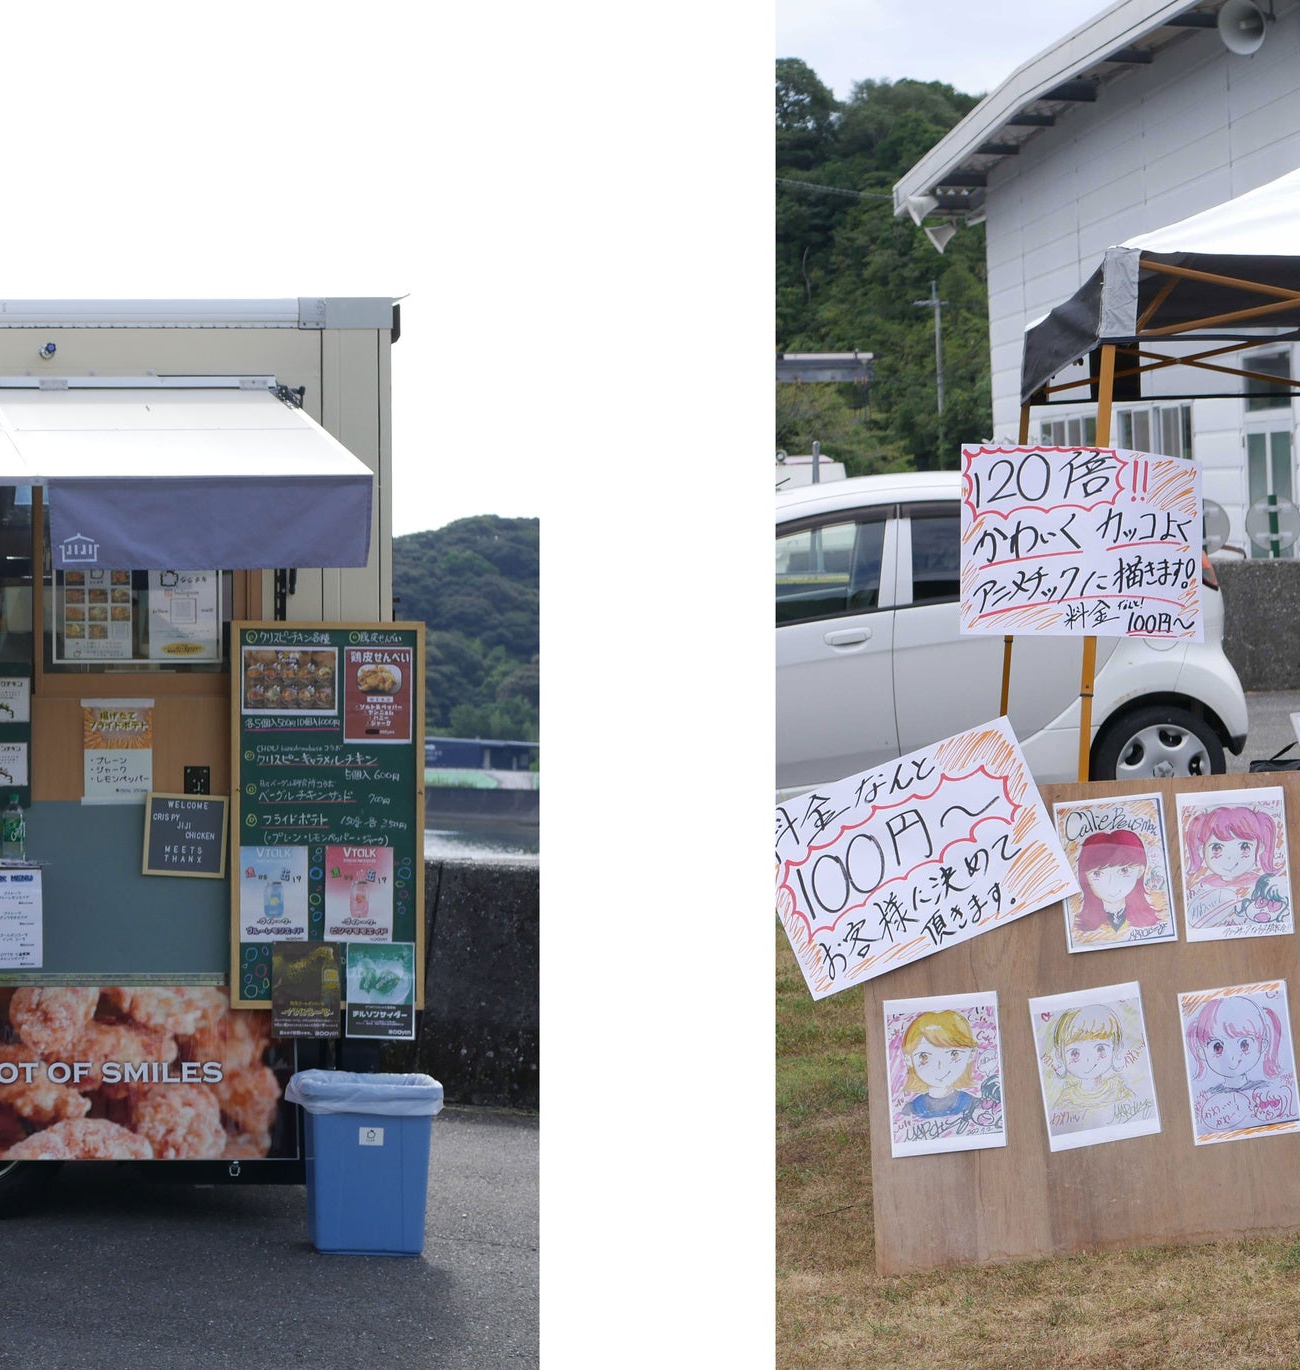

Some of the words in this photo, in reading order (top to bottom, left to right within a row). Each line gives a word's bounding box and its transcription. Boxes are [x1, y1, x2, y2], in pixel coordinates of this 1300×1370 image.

[973, 513, 1082, 564] かわいく
[1096, 509, 1193, 543] カッコよく
[1065, 599, 1120, 630] 料金
[351, 652, 410, 663] 鶏皮せんべい
[854, 757, 935, 808] なんと
[168, 801, 208, 810] WELCOME
[153, 813, 180, 821] CRISPY
[263, 813, 329, 826] フライドポテト
[177, 821, 191, 829] JIJI
[185, 832, 215, 840] CHICKEN
[165, 845, 202, 854] MEETS
[164, 855, 202, 864] THANX
[819, 834, 1022, 981] お客様に決めて
[47, 1062, 93, 1084] OF
[102, 1061, 224, 1084] SMILES
